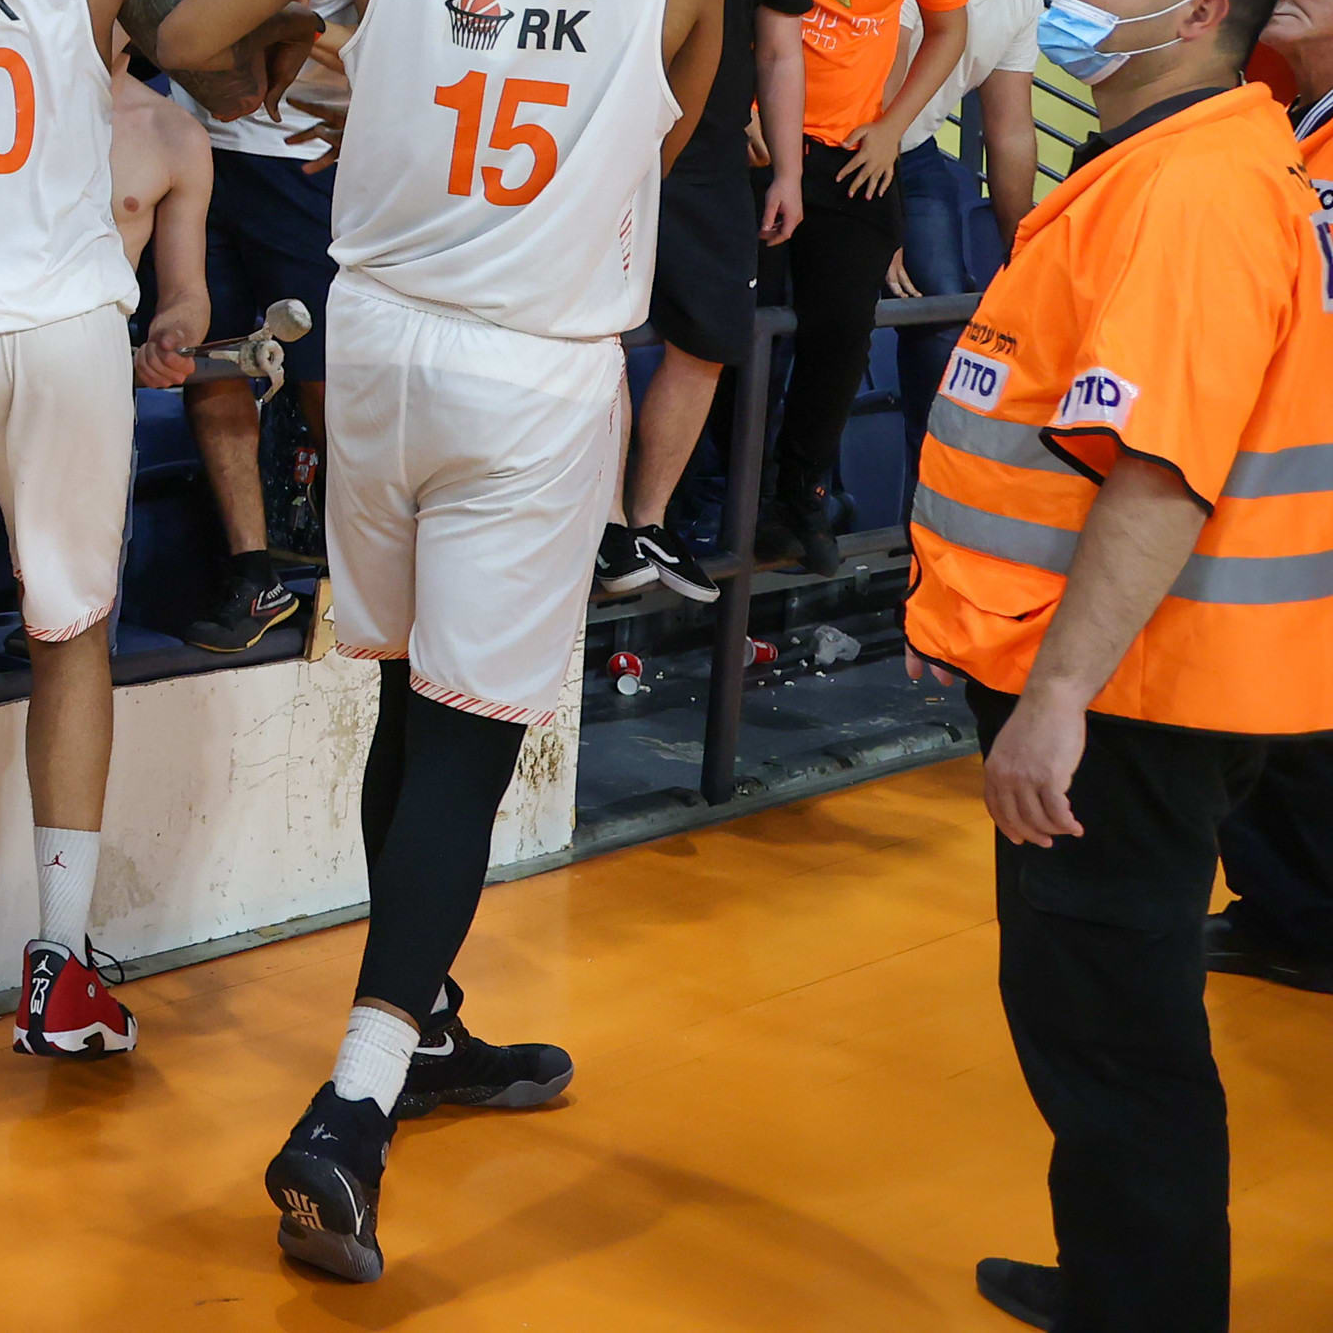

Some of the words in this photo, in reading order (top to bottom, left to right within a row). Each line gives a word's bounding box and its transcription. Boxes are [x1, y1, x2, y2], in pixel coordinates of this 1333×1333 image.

[517, 8, 591, 53] RK
[434, 70, 570, 206] 15
[949, 356, 997, 397] סדרן
[1062, 376, 1121, 417] סדרן
[29, 977, 50, 1015] 23
